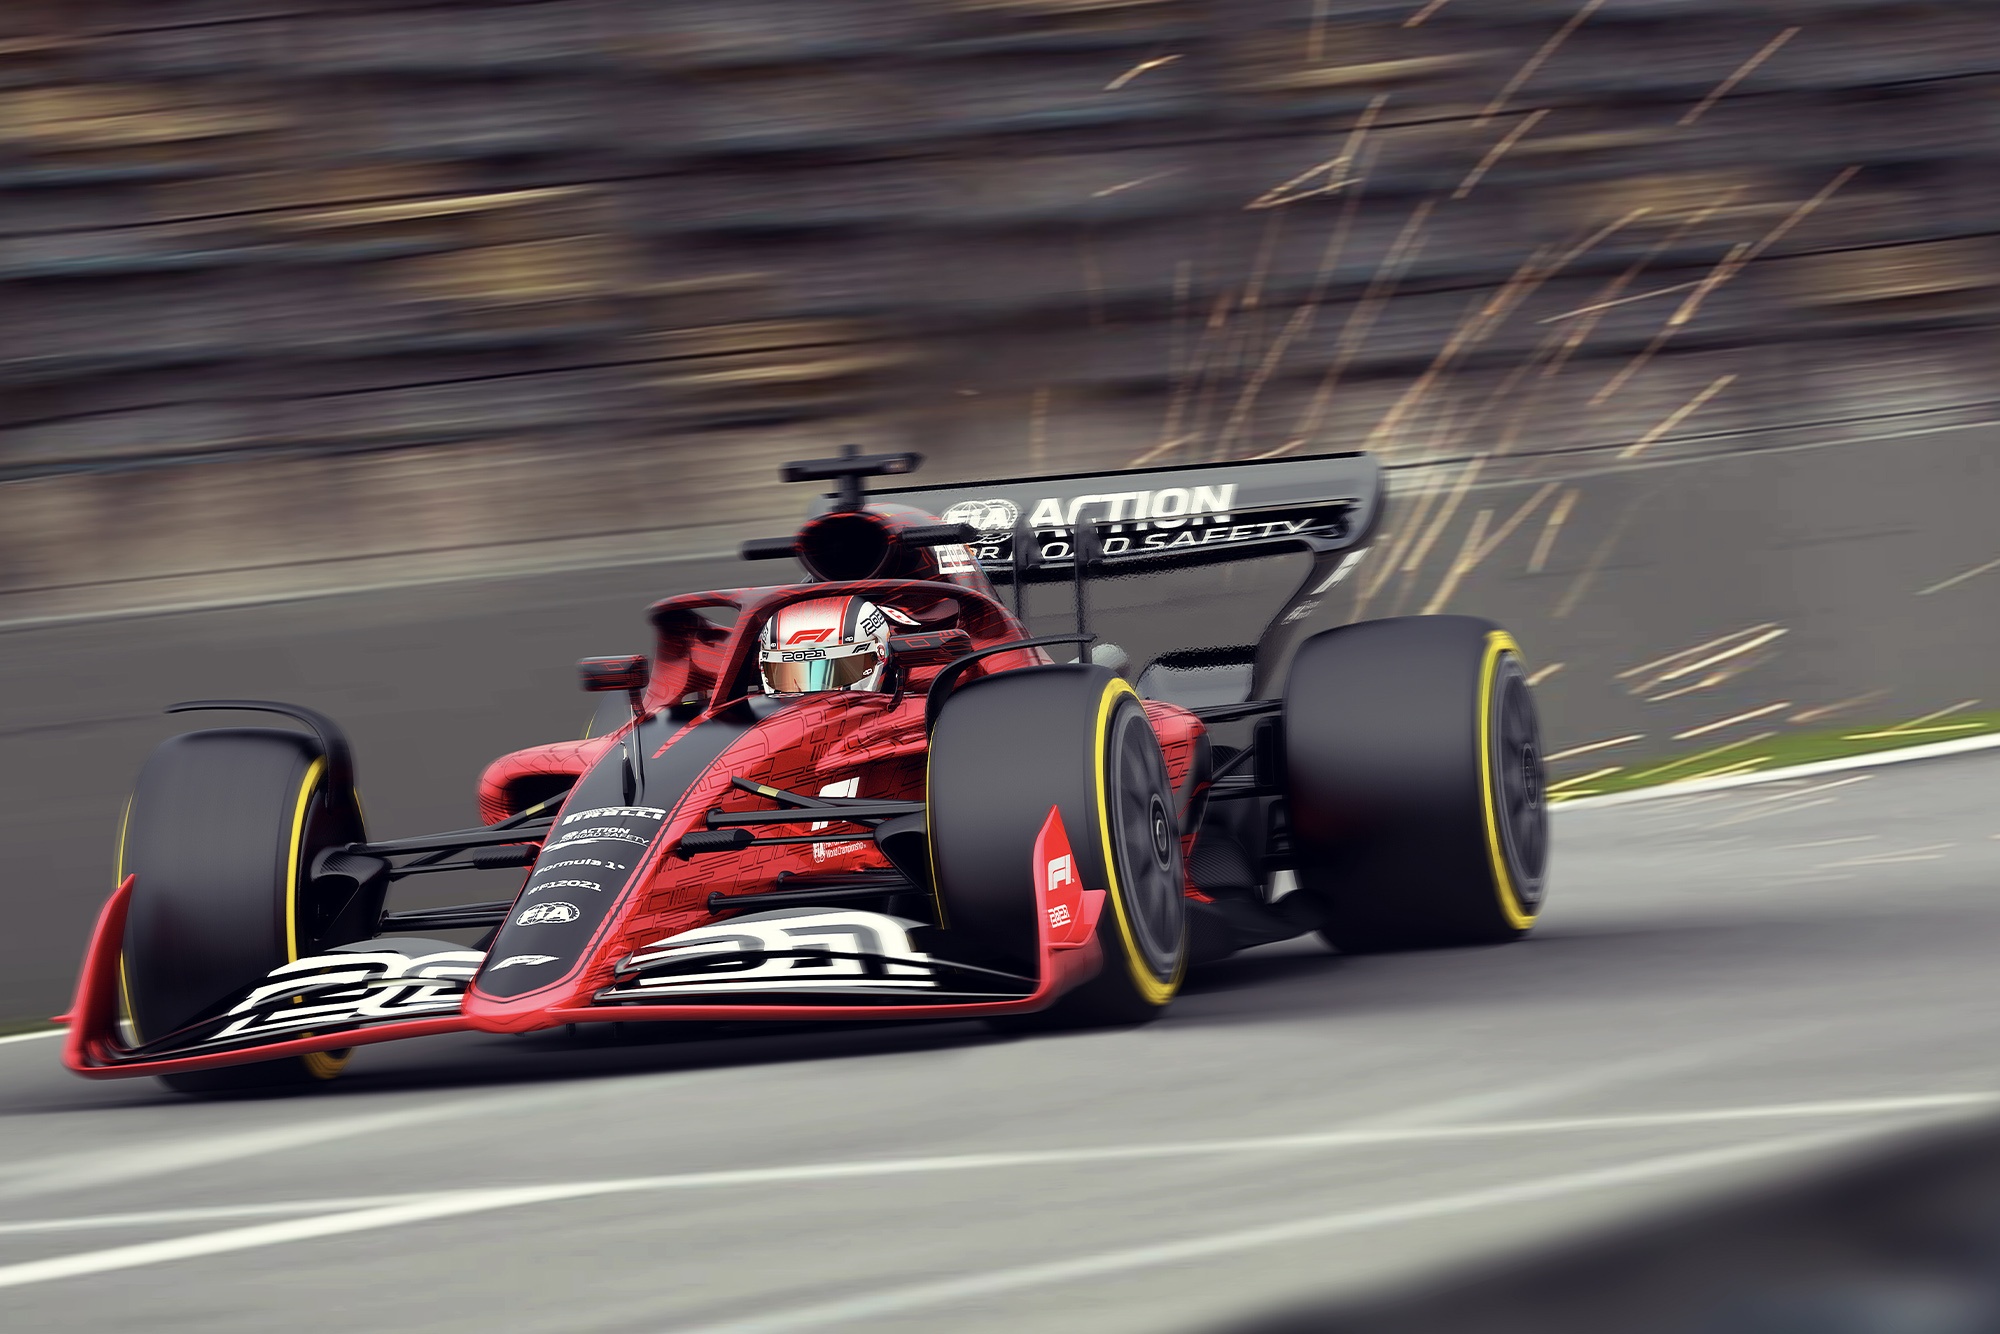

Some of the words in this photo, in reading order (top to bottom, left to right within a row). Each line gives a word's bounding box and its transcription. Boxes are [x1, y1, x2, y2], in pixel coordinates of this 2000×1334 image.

[1029, 483, 1239, 538] ACTION
[1144, 517, 1318, 550] SAFETY
[785, 628, 836, 645] F1
[782, 649, 827, 662] 2021
[562, 806, 667, 826] PIRELLI
[578, 826, 631, 835] ACTION
[1048, 853, 1072, 891] F1
[518, 904, 573, 923] FIA
